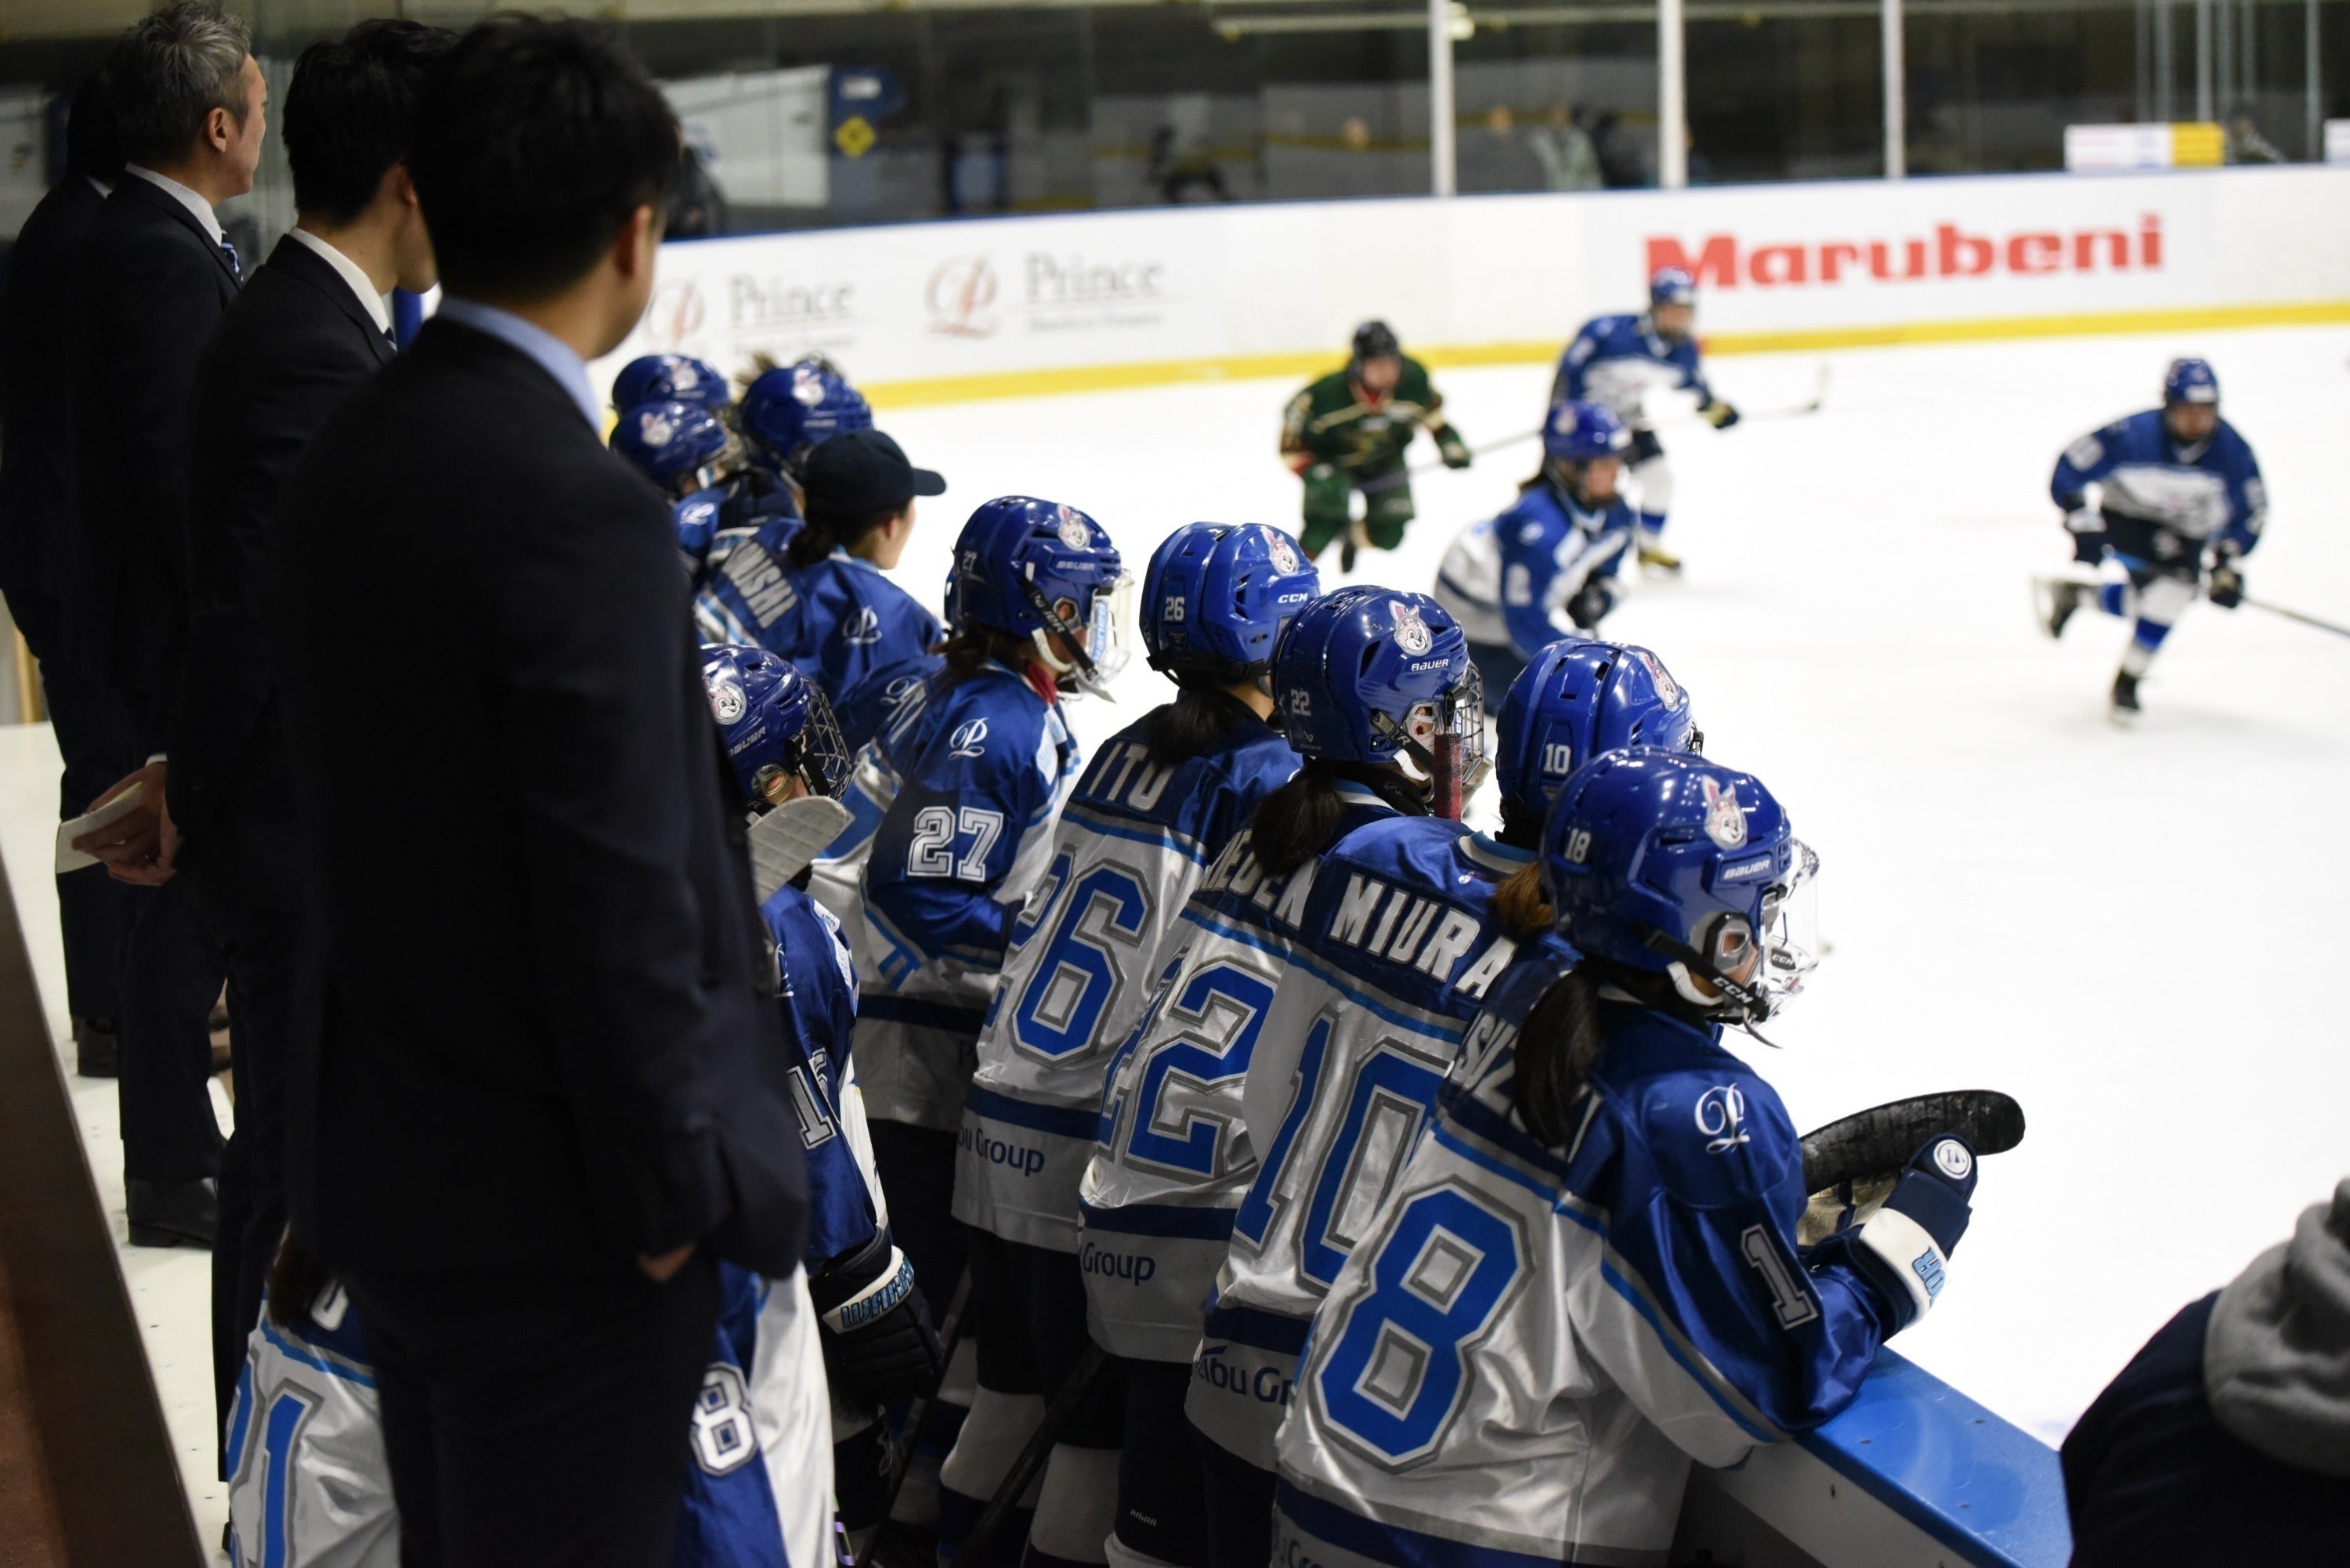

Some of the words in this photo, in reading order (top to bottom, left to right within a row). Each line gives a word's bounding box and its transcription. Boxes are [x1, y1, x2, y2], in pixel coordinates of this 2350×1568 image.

[1643, 213, 2163, 290] Marubeni
[728, 273, 855, 326] Prince
[1023, 251, 1166, 304] Prince
[963, 551, 978, 572] 27
[1164, 596, 1184, 622] 26
[1278, 593, 1308, 604] CCM
[1290, 688, 1311, 716] 22
[1543, 743, 1572, 775] 10
[907, 805, 1004, 883] 27
[1564, 828, 1592, 865] 18
[1330, 873, 1520, 1001] MIURA
[1712, 976, 1754, 1004] CCM
[976, 1128, 1045, 1177] Group
[1231, 1004, 1453, 1300] 10
[1083, 1241, 1156, 1287] Group
[1296, 1172, 1535, 1474] 8
